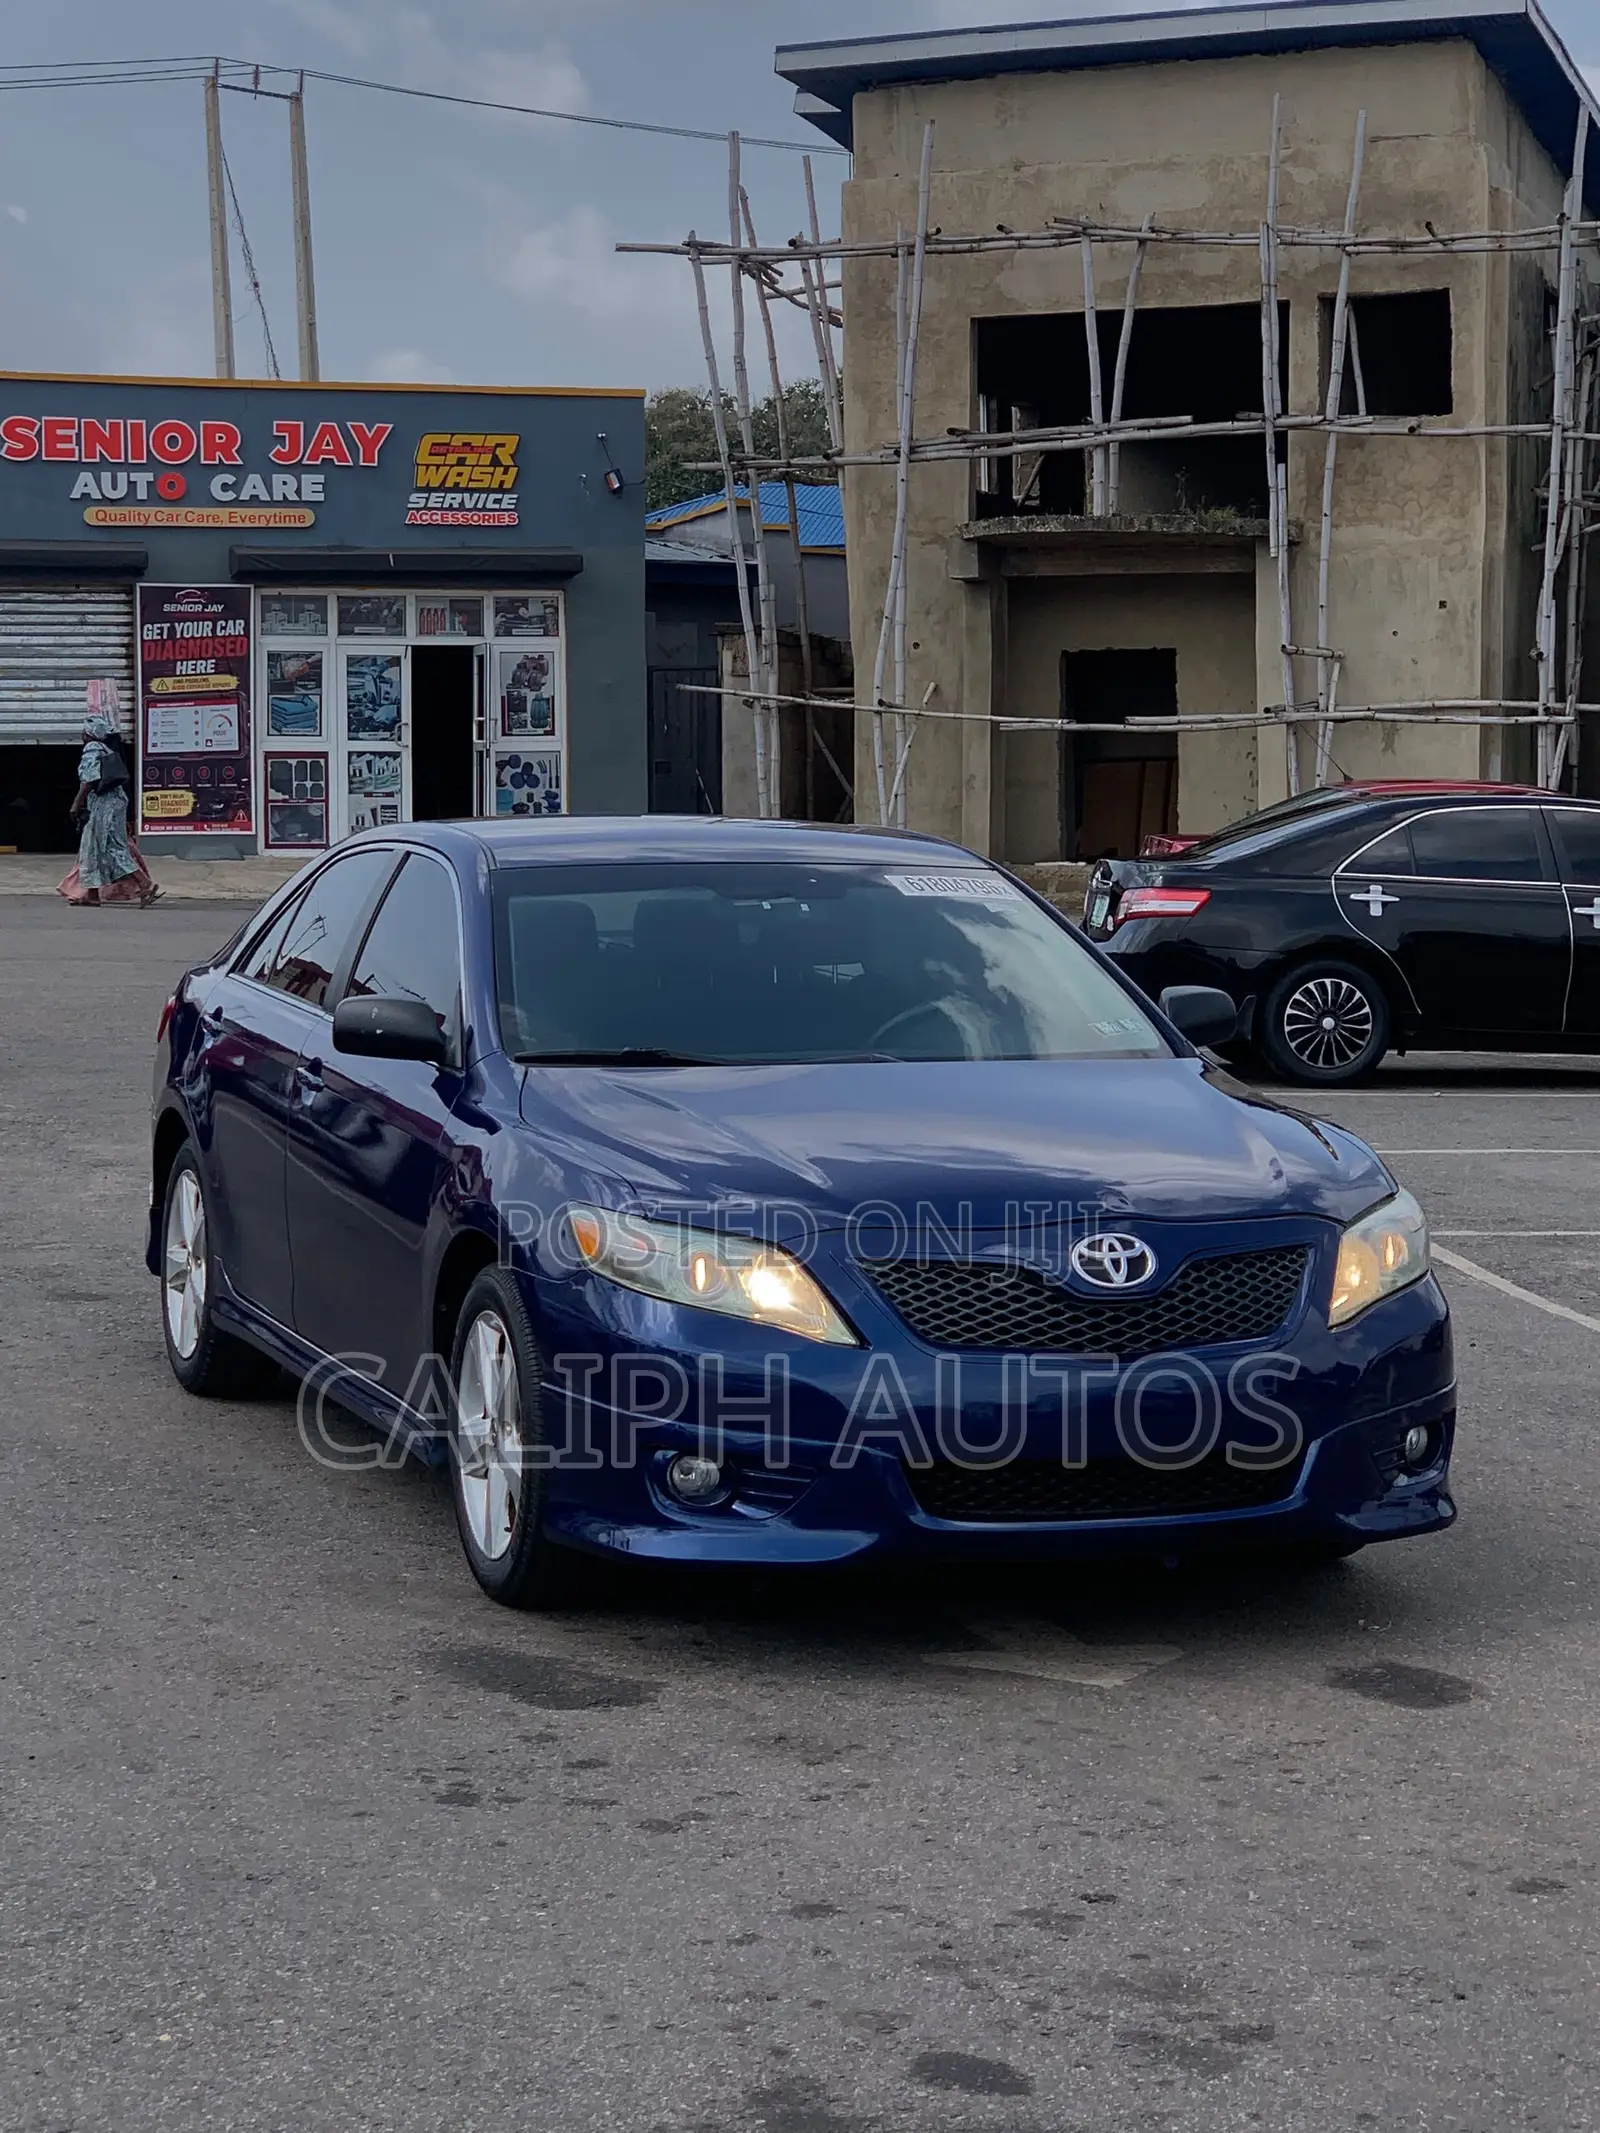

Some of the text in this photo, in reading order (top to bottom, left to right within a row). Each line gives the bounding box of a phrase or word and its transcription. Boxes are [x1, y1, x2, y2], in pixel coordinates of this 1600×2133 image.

[0, 415, 393, 467] SENIOR JAY
[415, 433, 520, 466] CAR
[69, 471, 325, 501] AUTO CARE
[415, 465, 519, 489] WASH
[407, 492, 519, 509] SERVICE
[94, 509, 306, 526] Quality Car Care, Everytime
[404, 510, 519, 526] ACCESSORIES
[163, 603, 225, 612] SENIOR JAY
[143, 620, 245, 640] GET YOUR CAR
[143, 637, 248, 661] DIAGNOSED
[176, 660, 216, 675] HERE
